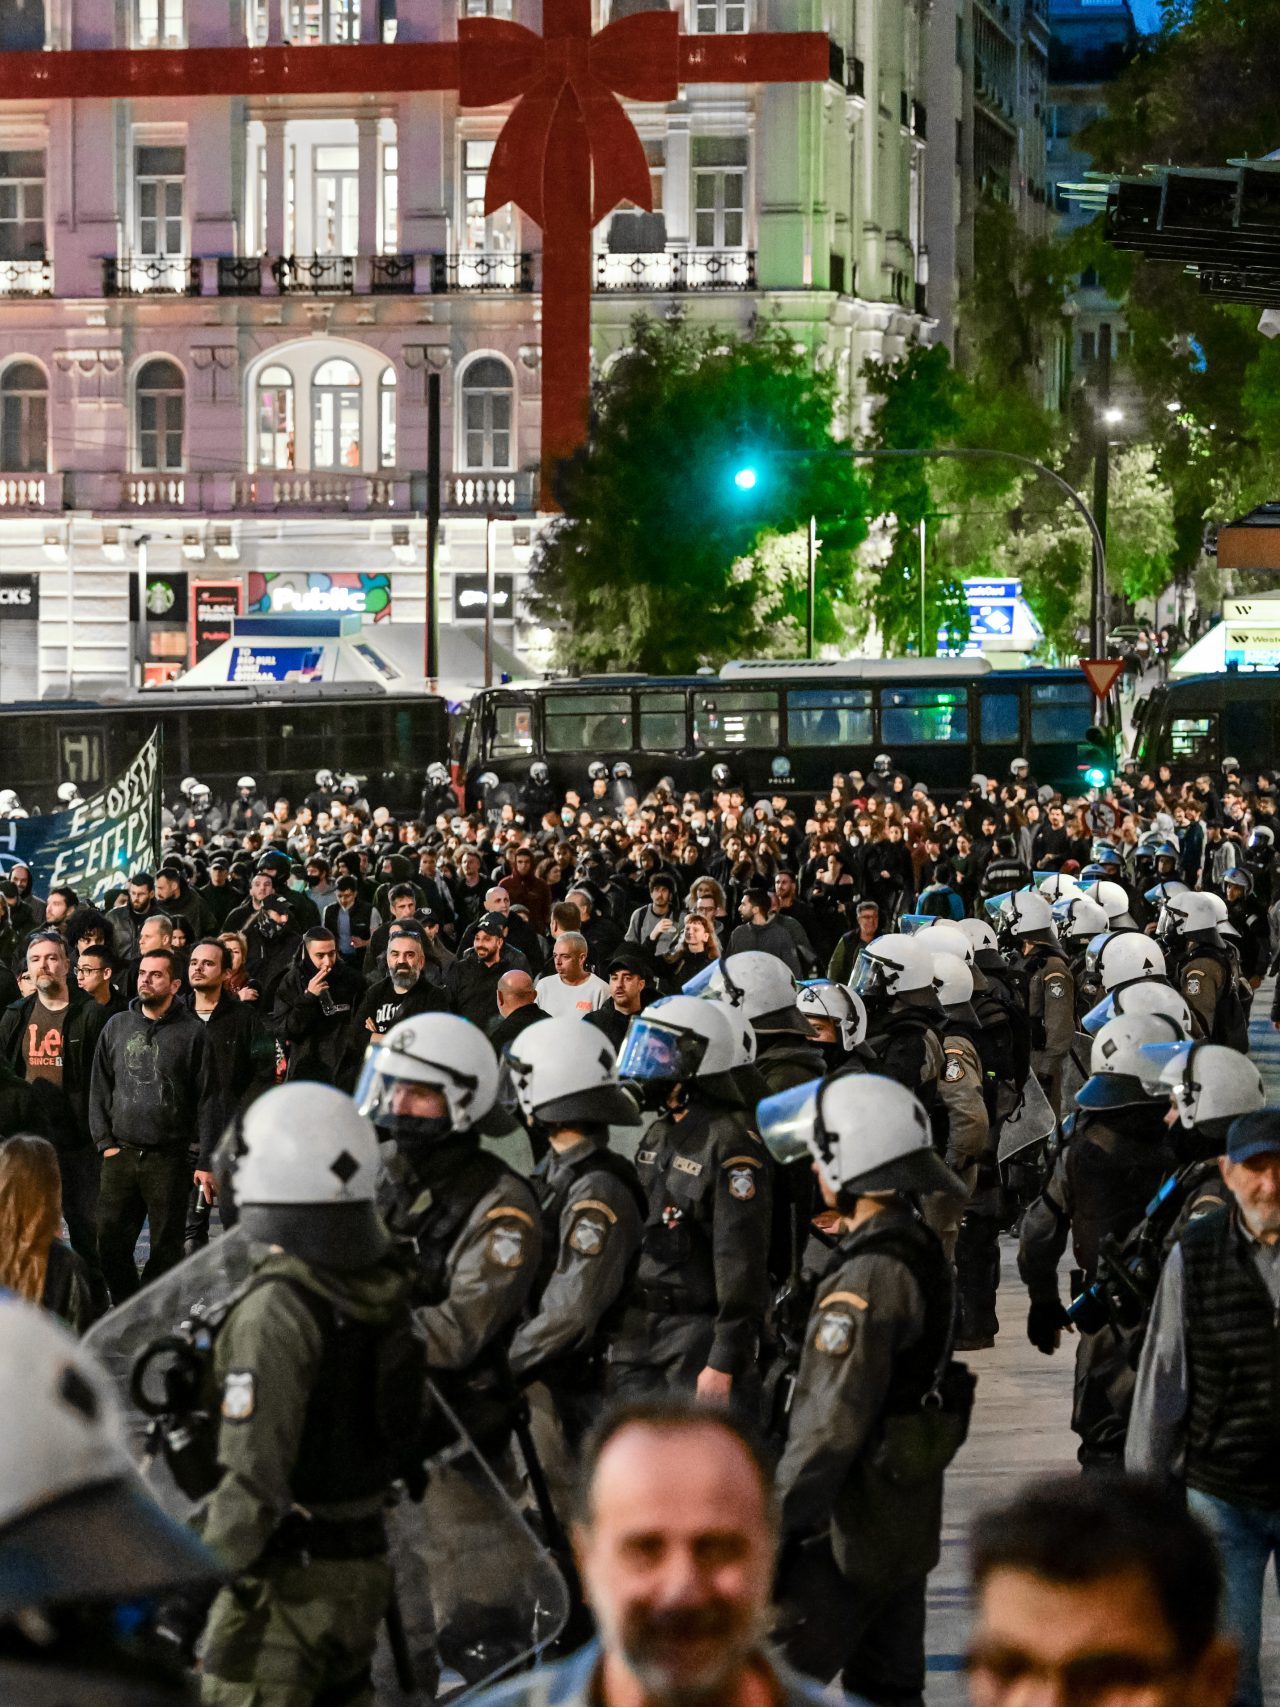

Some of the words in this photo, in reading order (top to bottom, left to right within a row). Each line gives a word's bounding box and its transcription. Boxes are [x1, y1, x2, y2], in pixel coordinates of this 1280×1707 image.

[272, 587, 366, 612] Public
[29, 1023, 64, 1057] Le
[29, 1057, 55, 1066] SINCE
